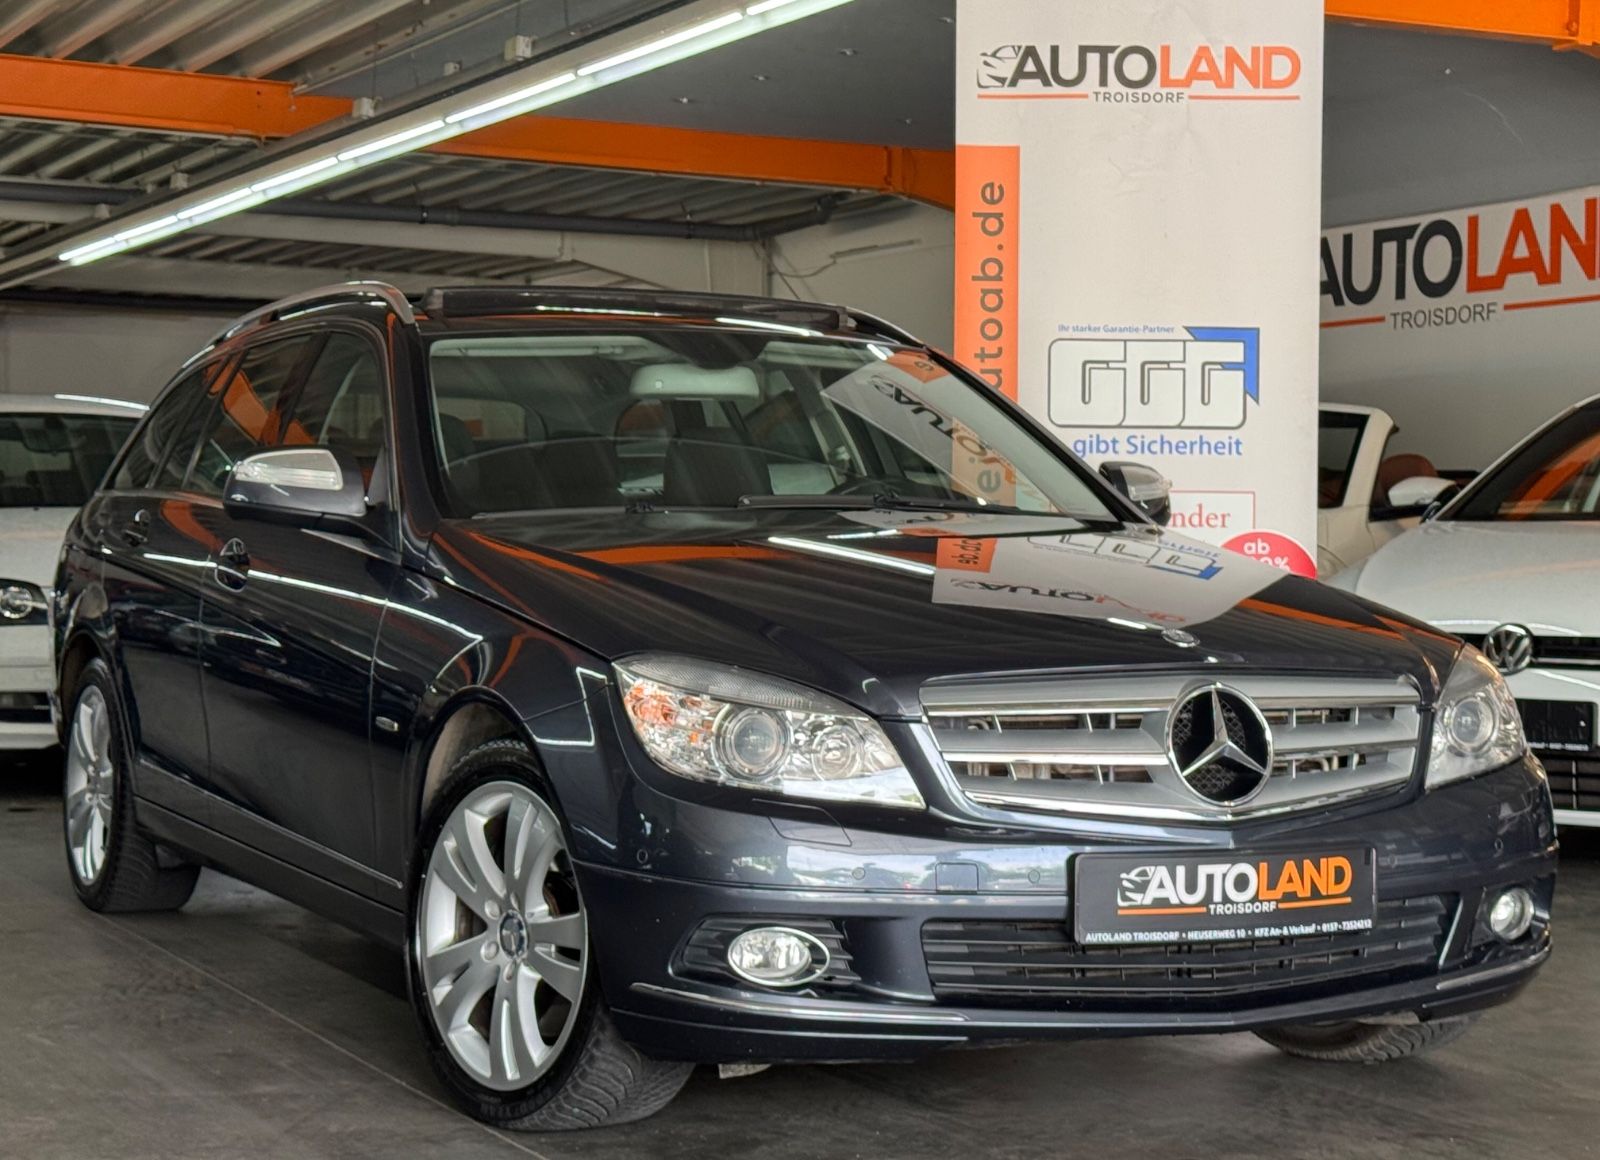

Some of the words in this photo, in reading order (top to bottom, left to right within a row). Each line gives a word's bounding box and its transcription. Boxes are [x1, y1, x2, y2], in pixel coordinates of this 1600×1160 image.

[1007, 45, 1301, 89] AUTOLAND
[1092, 91, 1185, 104] TROISDORF
[1320, 196, 1600, 307] AUTOLAN
[1390, 302, 1498, 330] TROISDORF
[1057, 324, 1070, 333] Ihr
[1072, 324, 1101, 334] starker
[1073, 434, 1120, 458] gibt
[1125, 434, 1243, 457] Sicherheit
[1243, 537, 1271, 556] ab
[1141, 856, 1353, 905] AUTOLAND
[1208, 900, 1277, 916] TROISDORF
[1085, 931, 1132, 943] AUTOLAND
[1133, 930, 1180, 942] TROISDORF
[1187, 929, 1236, 940] HEUSERWEG
[1254, 926, 1270, 938] KFZ
